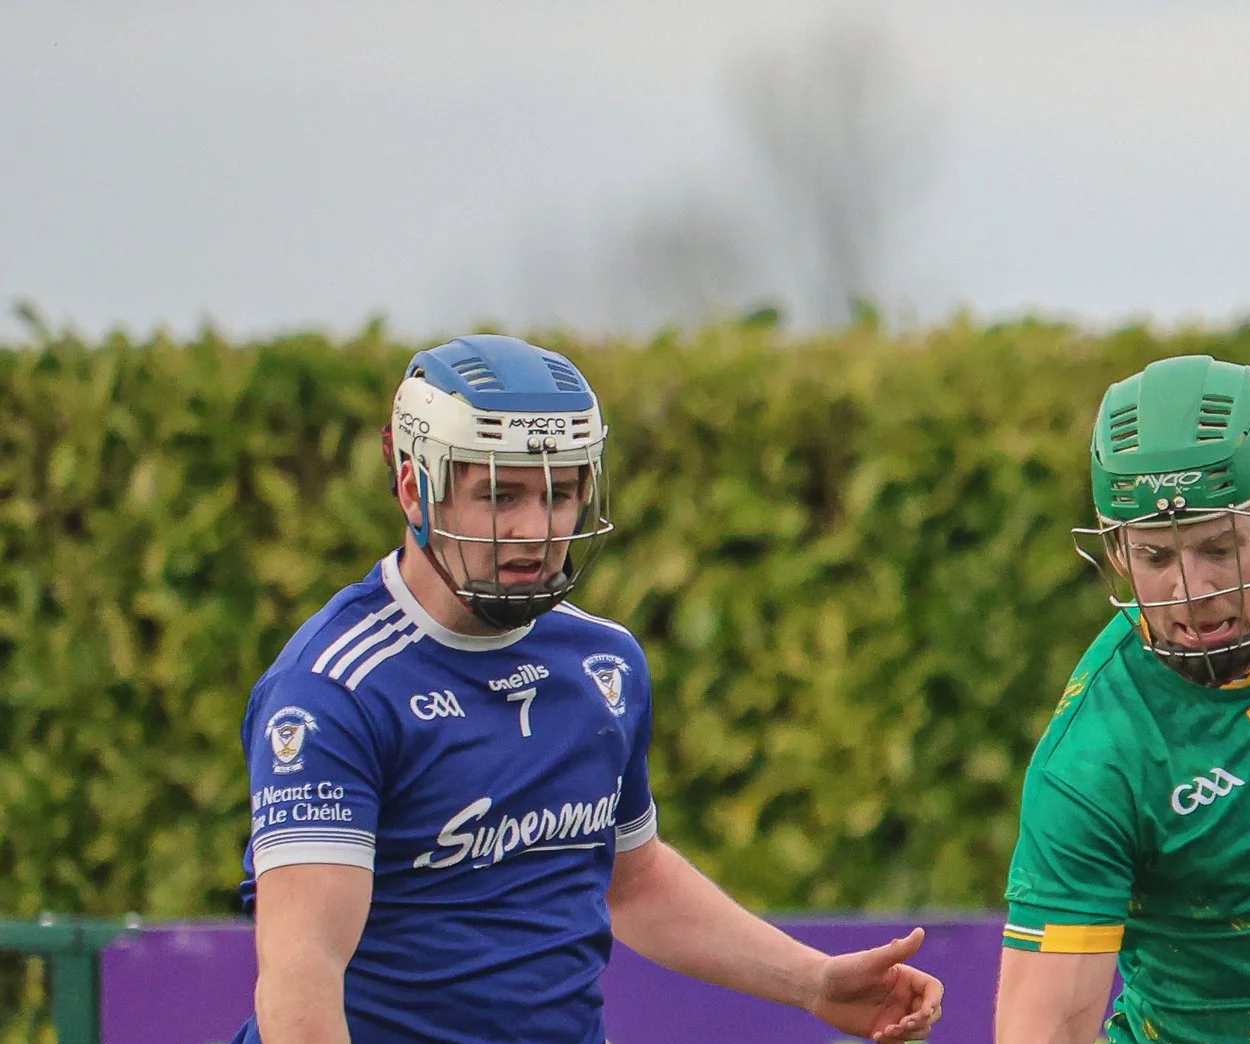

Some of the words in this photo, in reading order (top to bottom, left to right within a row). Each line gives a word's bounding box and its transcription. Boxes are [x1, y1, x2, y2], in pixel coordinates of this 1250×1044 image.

[409, 689, 466, 721] GAA
[507, 686, 538, 738] 7
[262, 783, 312, 806] Neart
[317, 781, 344, 800] Go
[1171, 767, 1246, 816] GAA
[268, 807, 288, 826] Le
